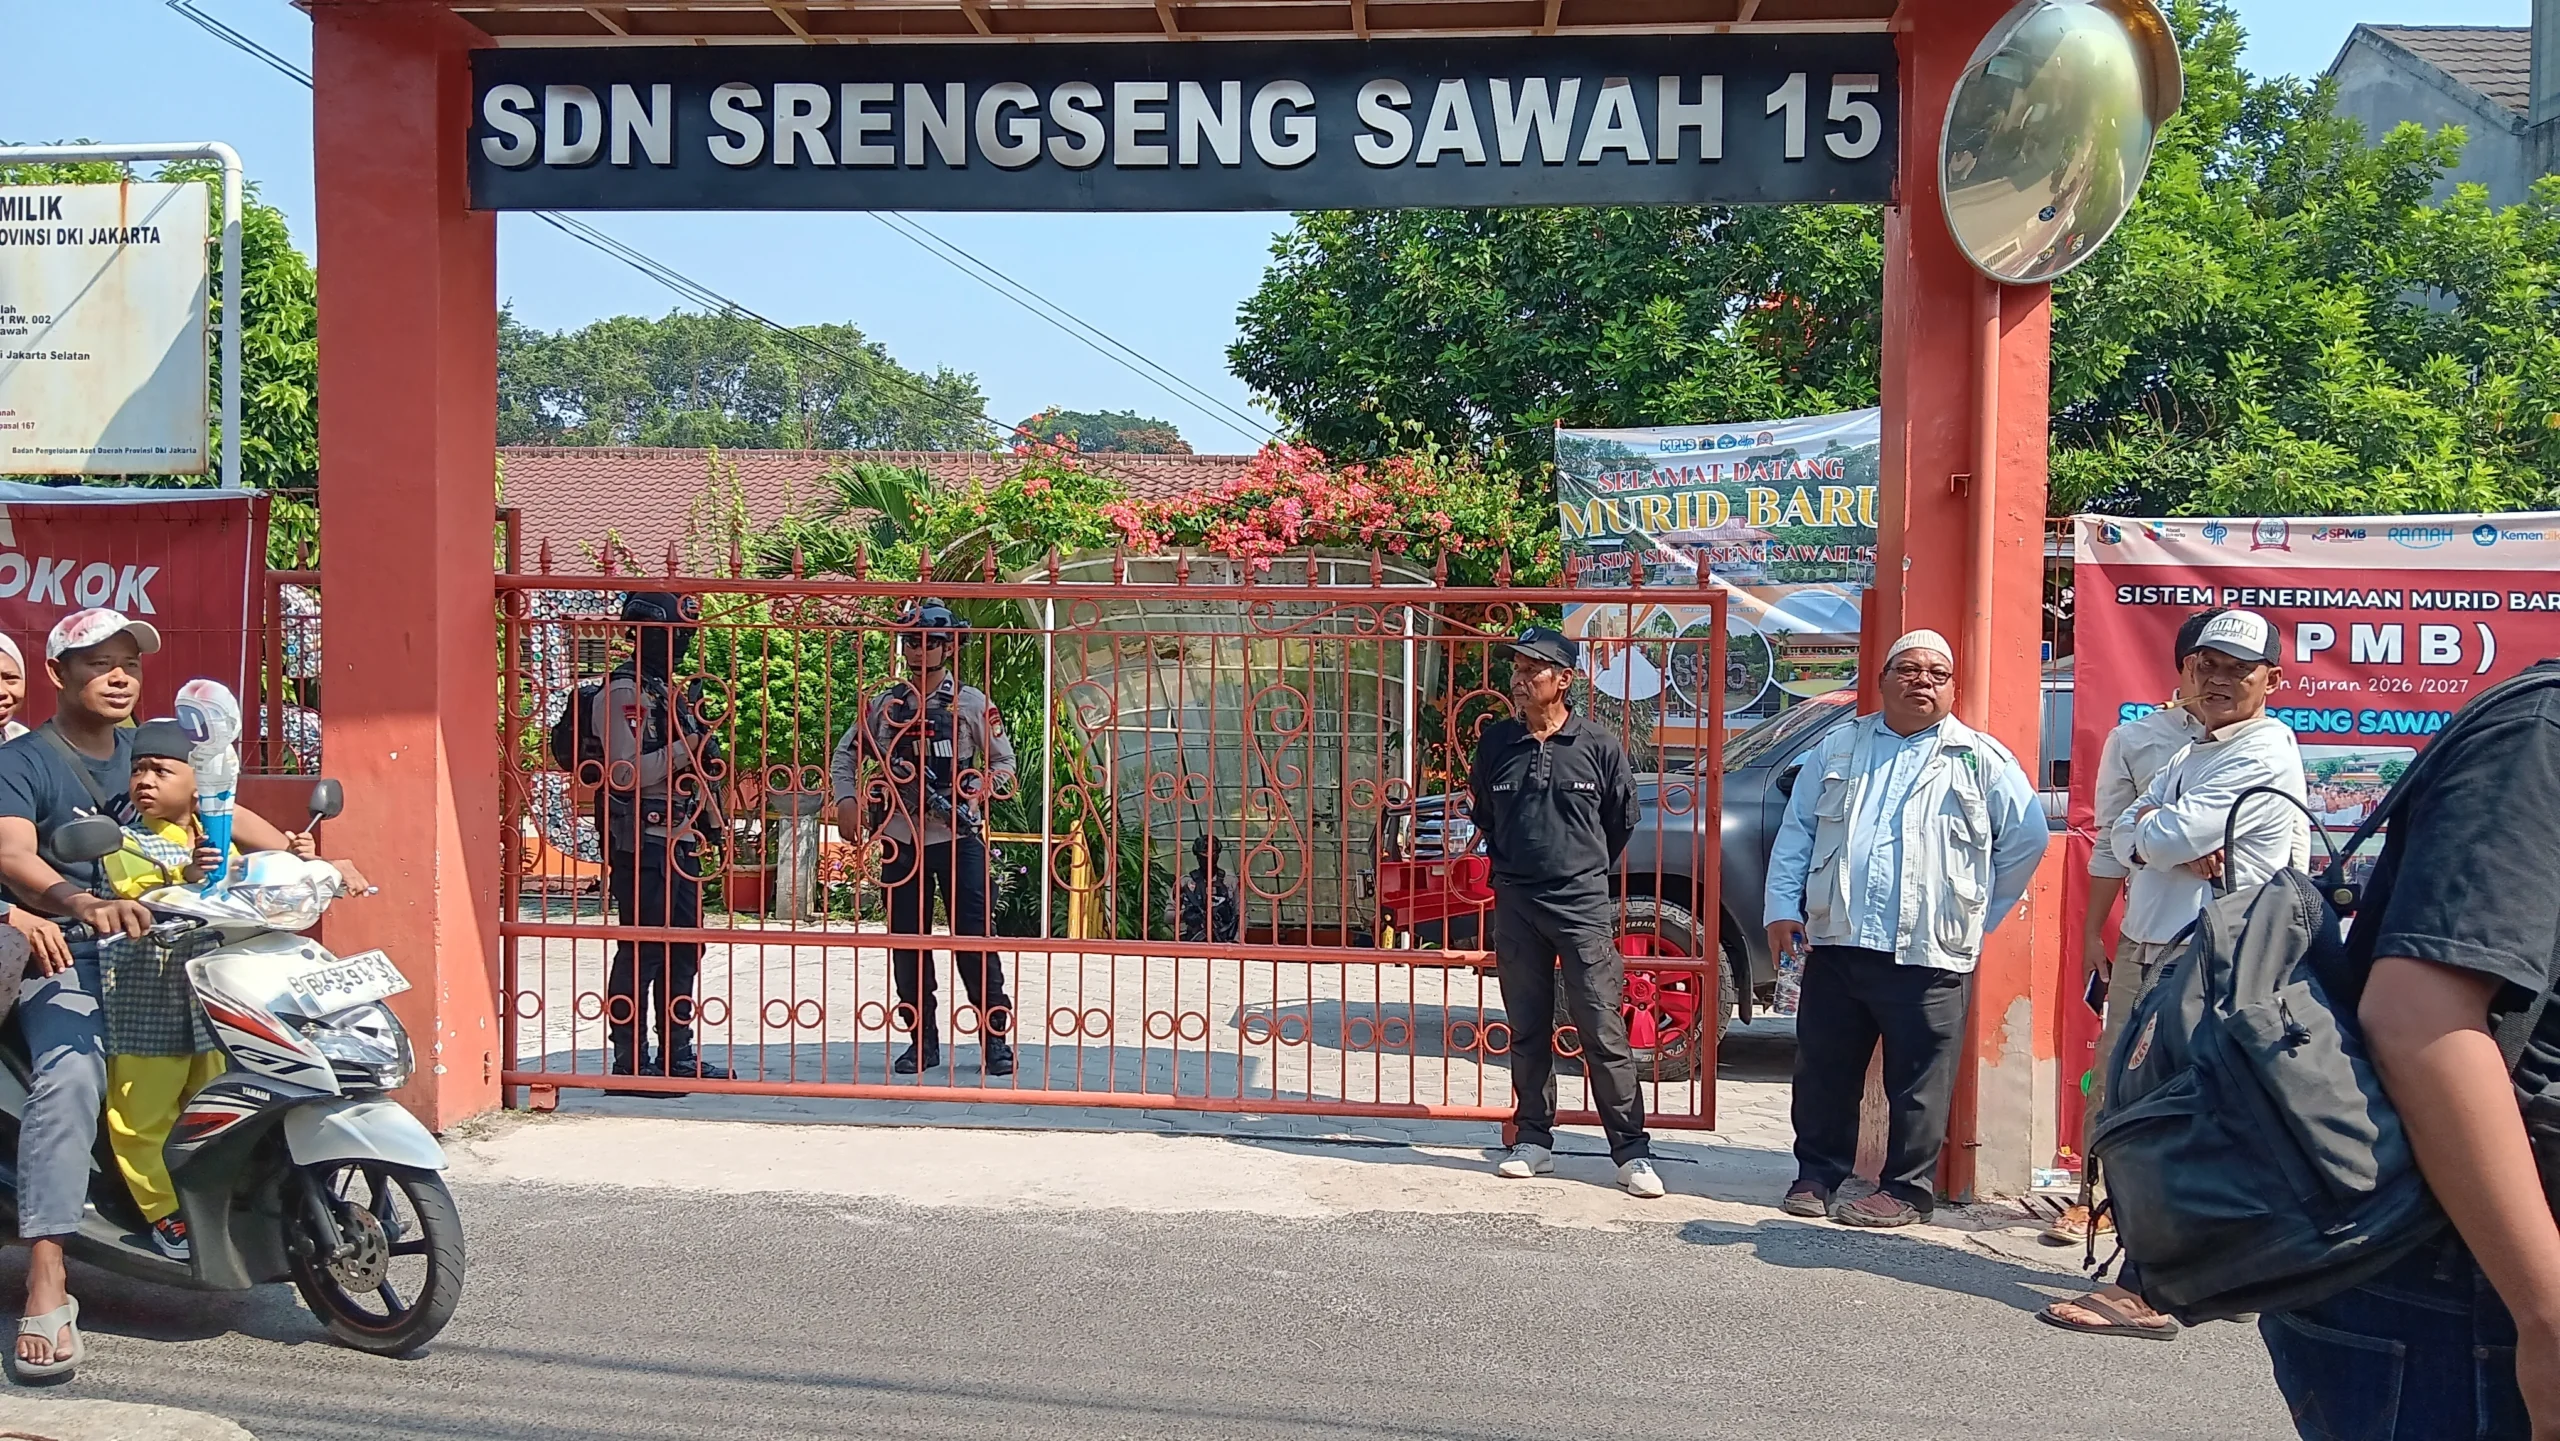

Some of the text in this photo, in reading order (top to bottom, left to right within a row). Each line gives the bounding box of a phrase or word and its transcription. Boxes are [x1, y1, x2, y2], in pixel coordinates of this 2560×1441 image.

[481, 72, 1883, 169] SDN SRENGSENG SAWAH 15
[0, 195, 63, 221] MILIK
[56, 228, 83, 246] DKI
[88, 226, 161, 246] JAKARTA
[9, 315, 29, 324] RW.
[31, 315, 52, 324] 002
[6, 350, 47, 360] Jakarta
[50, 350, 90, 361] Selatan
[21, 421, 36, 430] 167
[12, 446, 34, 454] Badan
[124, 446, 153, 454] Provinsi
[168, 446, 197, 454] Jakarta
[1660, 438, 1697, 452] MPLS
[1598, 457, 1845, 494] SELAMAT DATANG
[1559, 490, 1730, 542] MURID
[2329, 527, 2367, 539] SPMB
[2387, 527, 2454, 542] RAMAH
[1577, 554, 1595, 573] DI
[1598, 550, 1642, 570] SDN
[1771, 544, 1852, 564] SAWAH
[1854, 544, 1878, 563] 15
[2117, 585, 2213, 604] SISTEM
[2223, 587, 2402, 608] PENERIMAAN
[2412, 590, 2500, 610] MURID
[2298, 675, 2361, 697] Ajaran
[2368, 677, 2413, 693] 2026
[2358, 709, 2453, 735] SAWA
[1624, 920, 1657, 929] ERRAIN
[241, 1085, 271, 1102] YAMAHA
